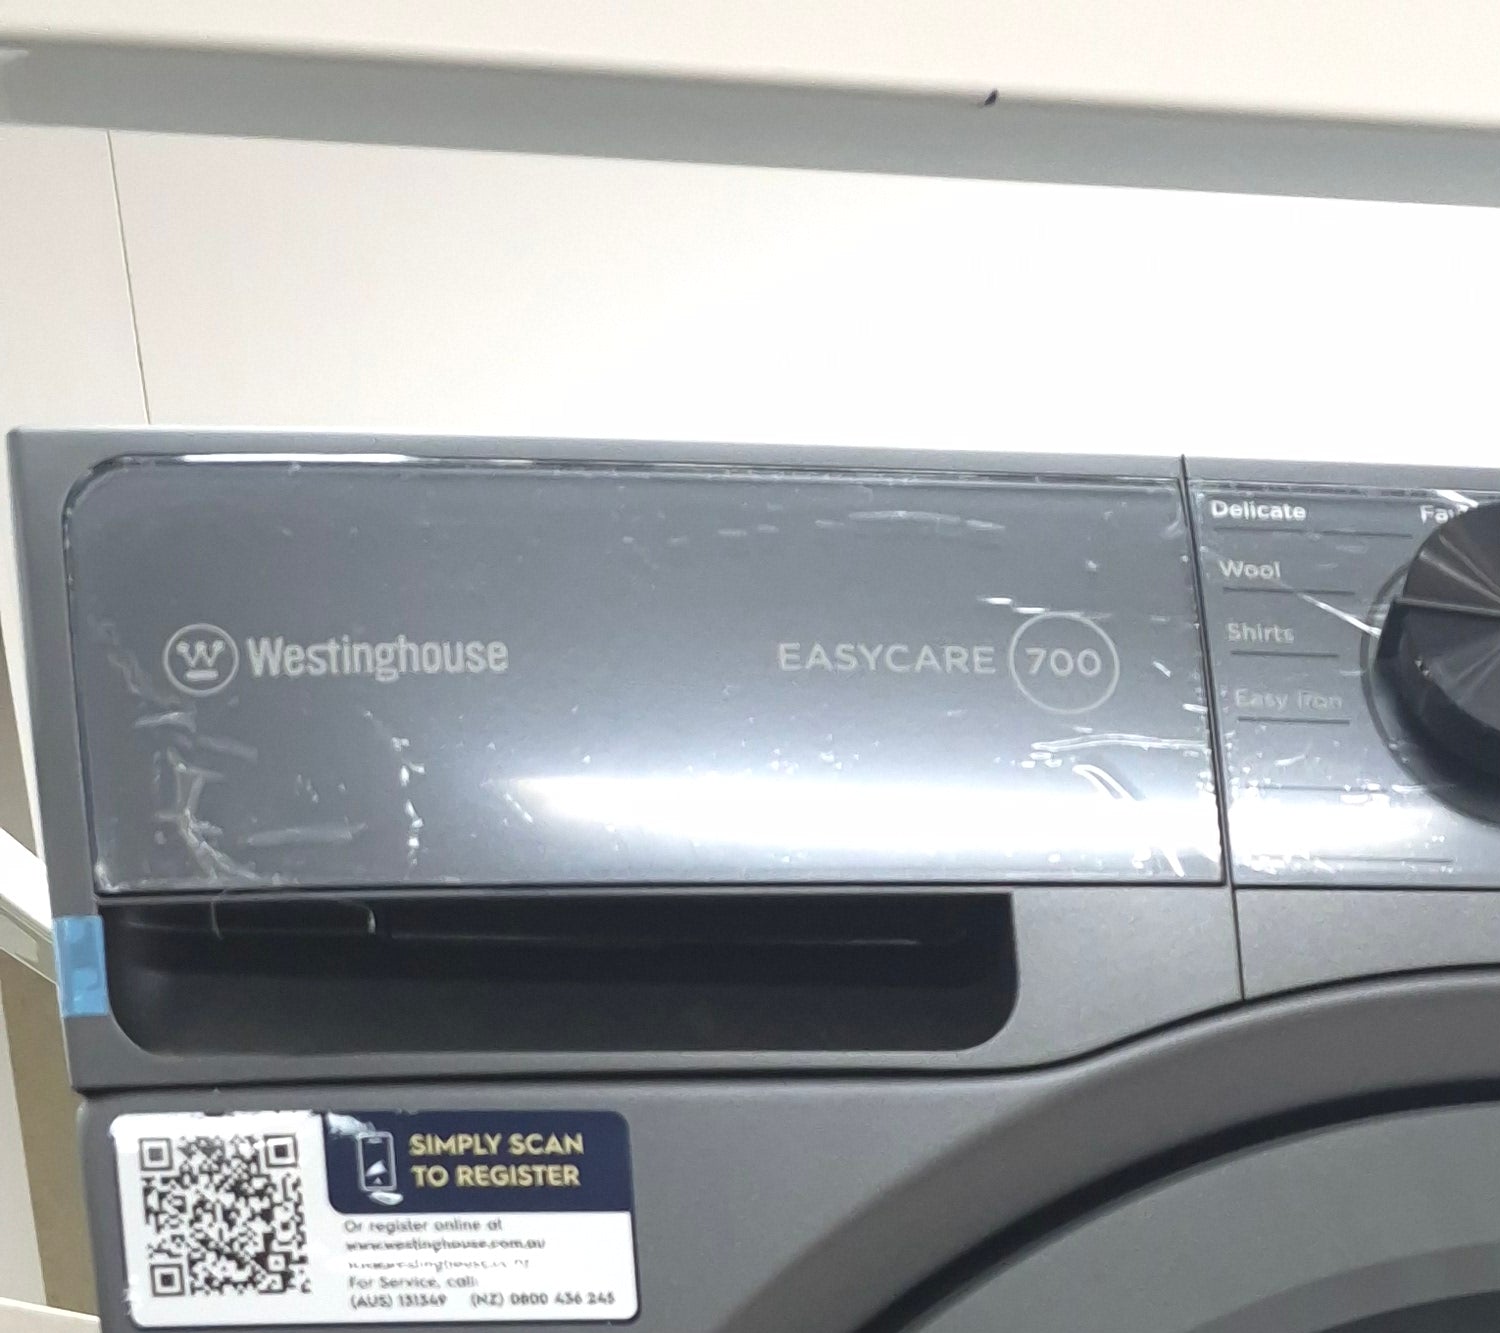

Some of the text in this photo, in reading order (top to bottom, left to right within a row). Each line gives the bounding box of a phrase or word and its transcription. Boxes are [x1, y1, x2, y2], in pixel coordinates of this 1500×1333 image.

[1211, 499, 1307, 522] Delicate
[1218, 559, 1281, 579] Wool
[1227, 621, 1295, 643] Shirts
[247, 636, 509, 681] Westinghouse
[778, 642, 1102, 676] EASYCARE 700
[408, 1132, 585, 1156] SIMPLY SCAN
[411, 1164, 582, 1188] TO REGISTER
[344, 1219, 362, 1233] Or
[369, 1217, 427, 1235] register
[433, 1217, 481, 1233] online
